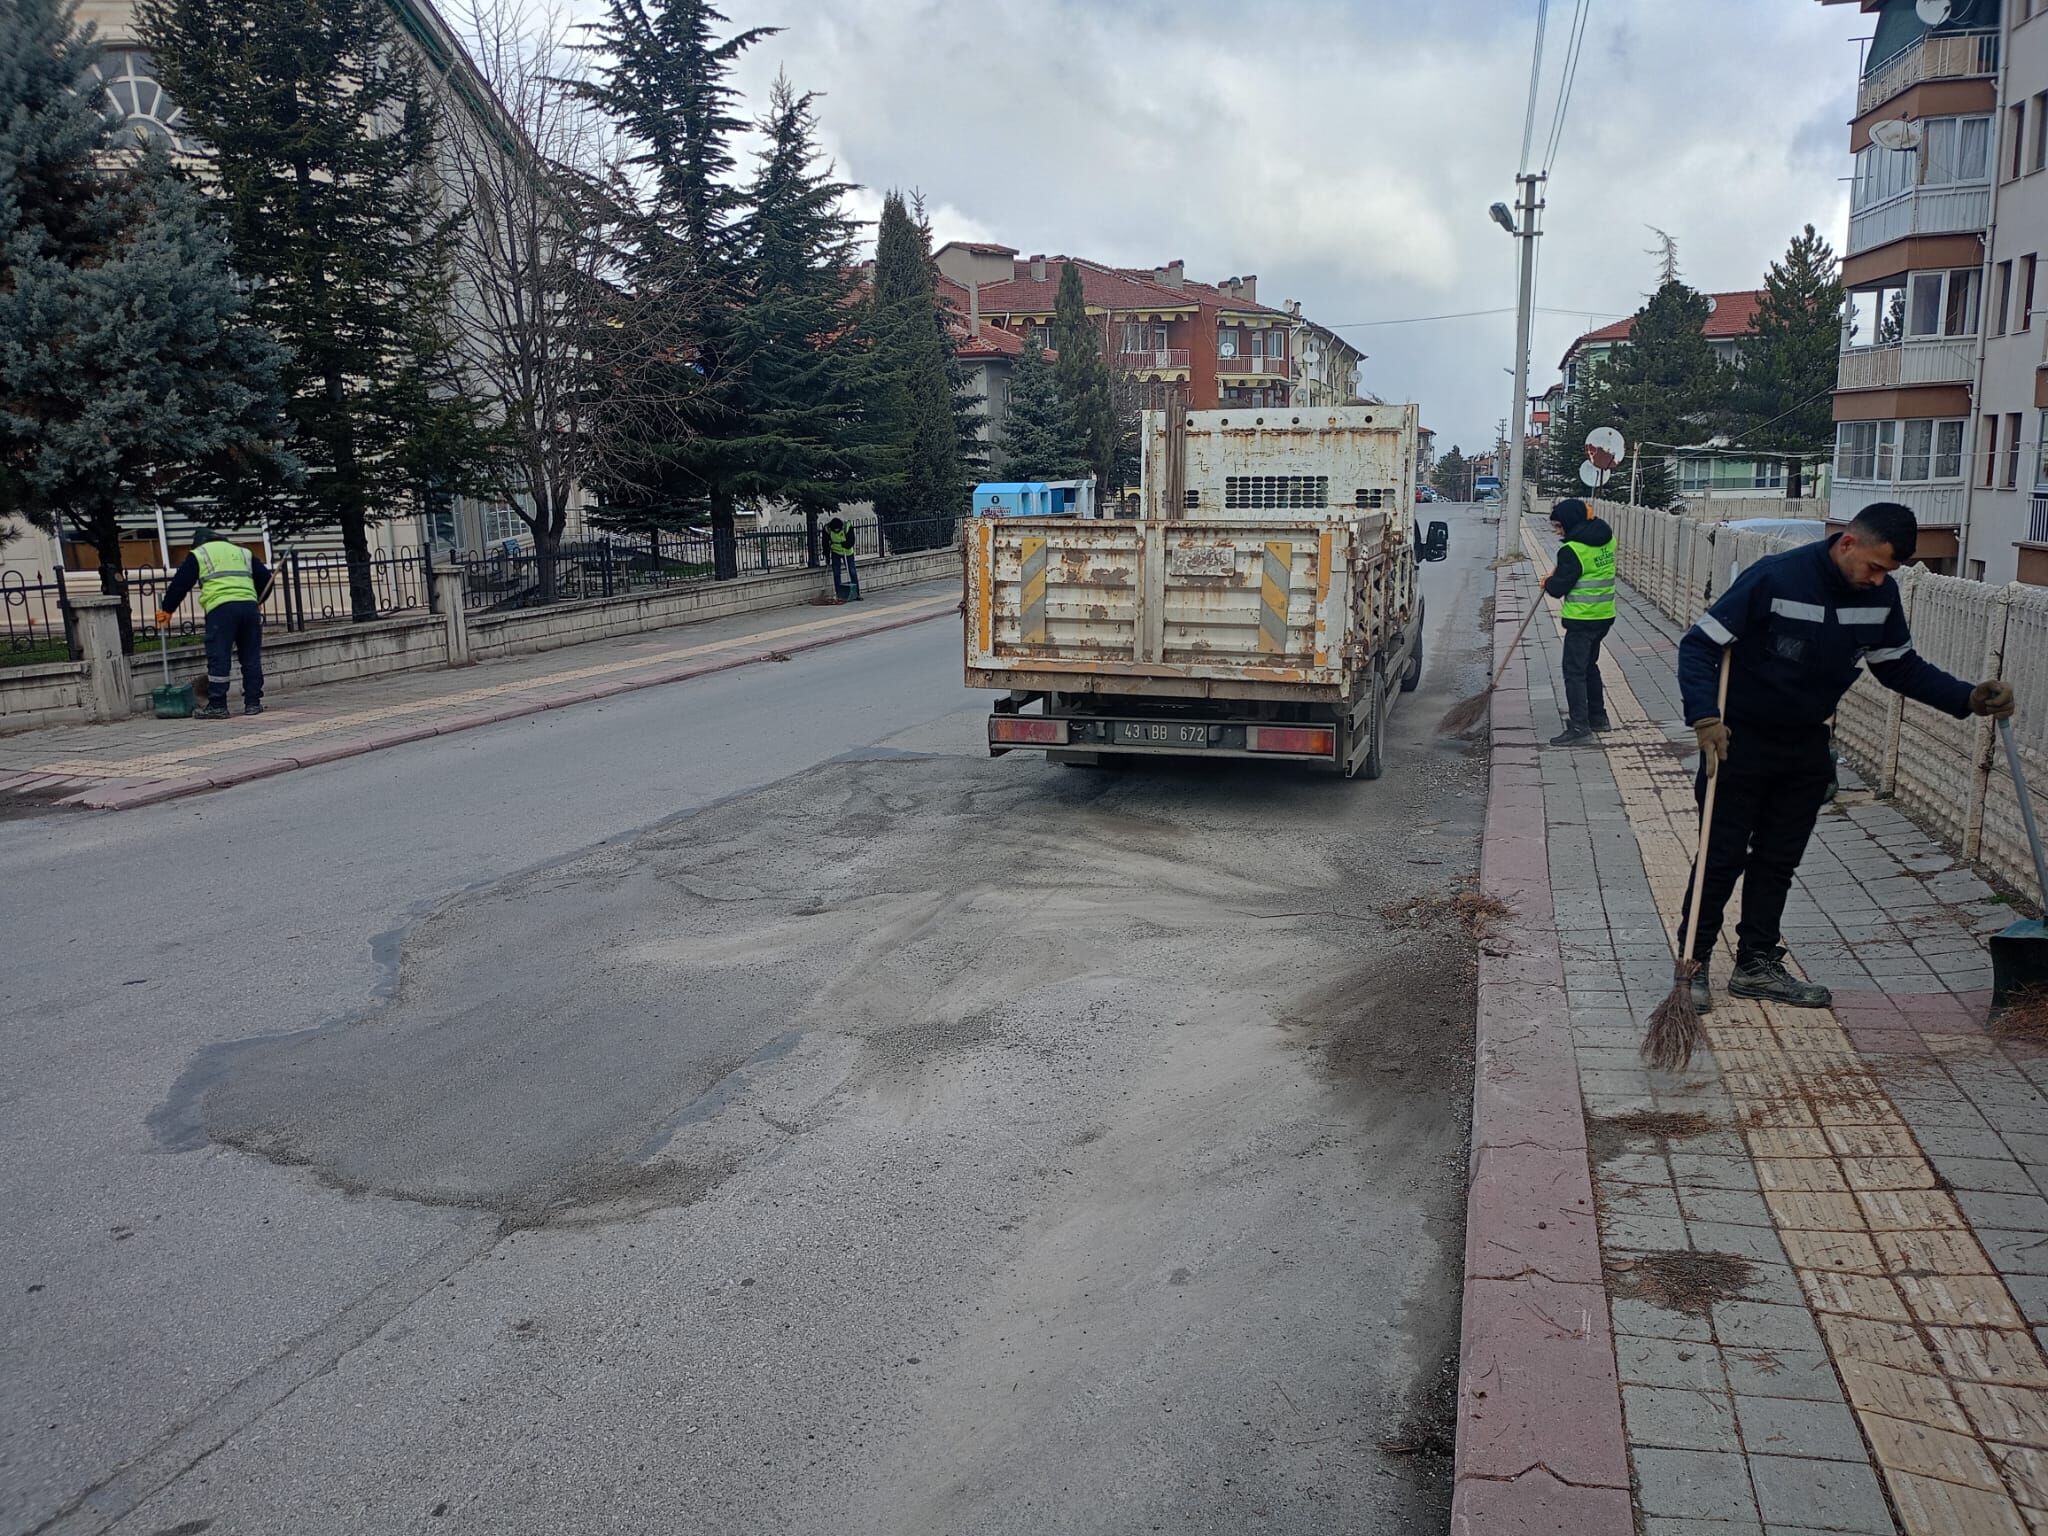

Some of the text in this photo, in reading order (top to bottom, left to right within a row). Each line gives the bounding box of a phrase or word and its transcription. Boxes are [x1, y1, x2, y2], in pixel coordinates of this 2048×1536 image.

[1125, 723, 1204, 742] 43 BB 672
